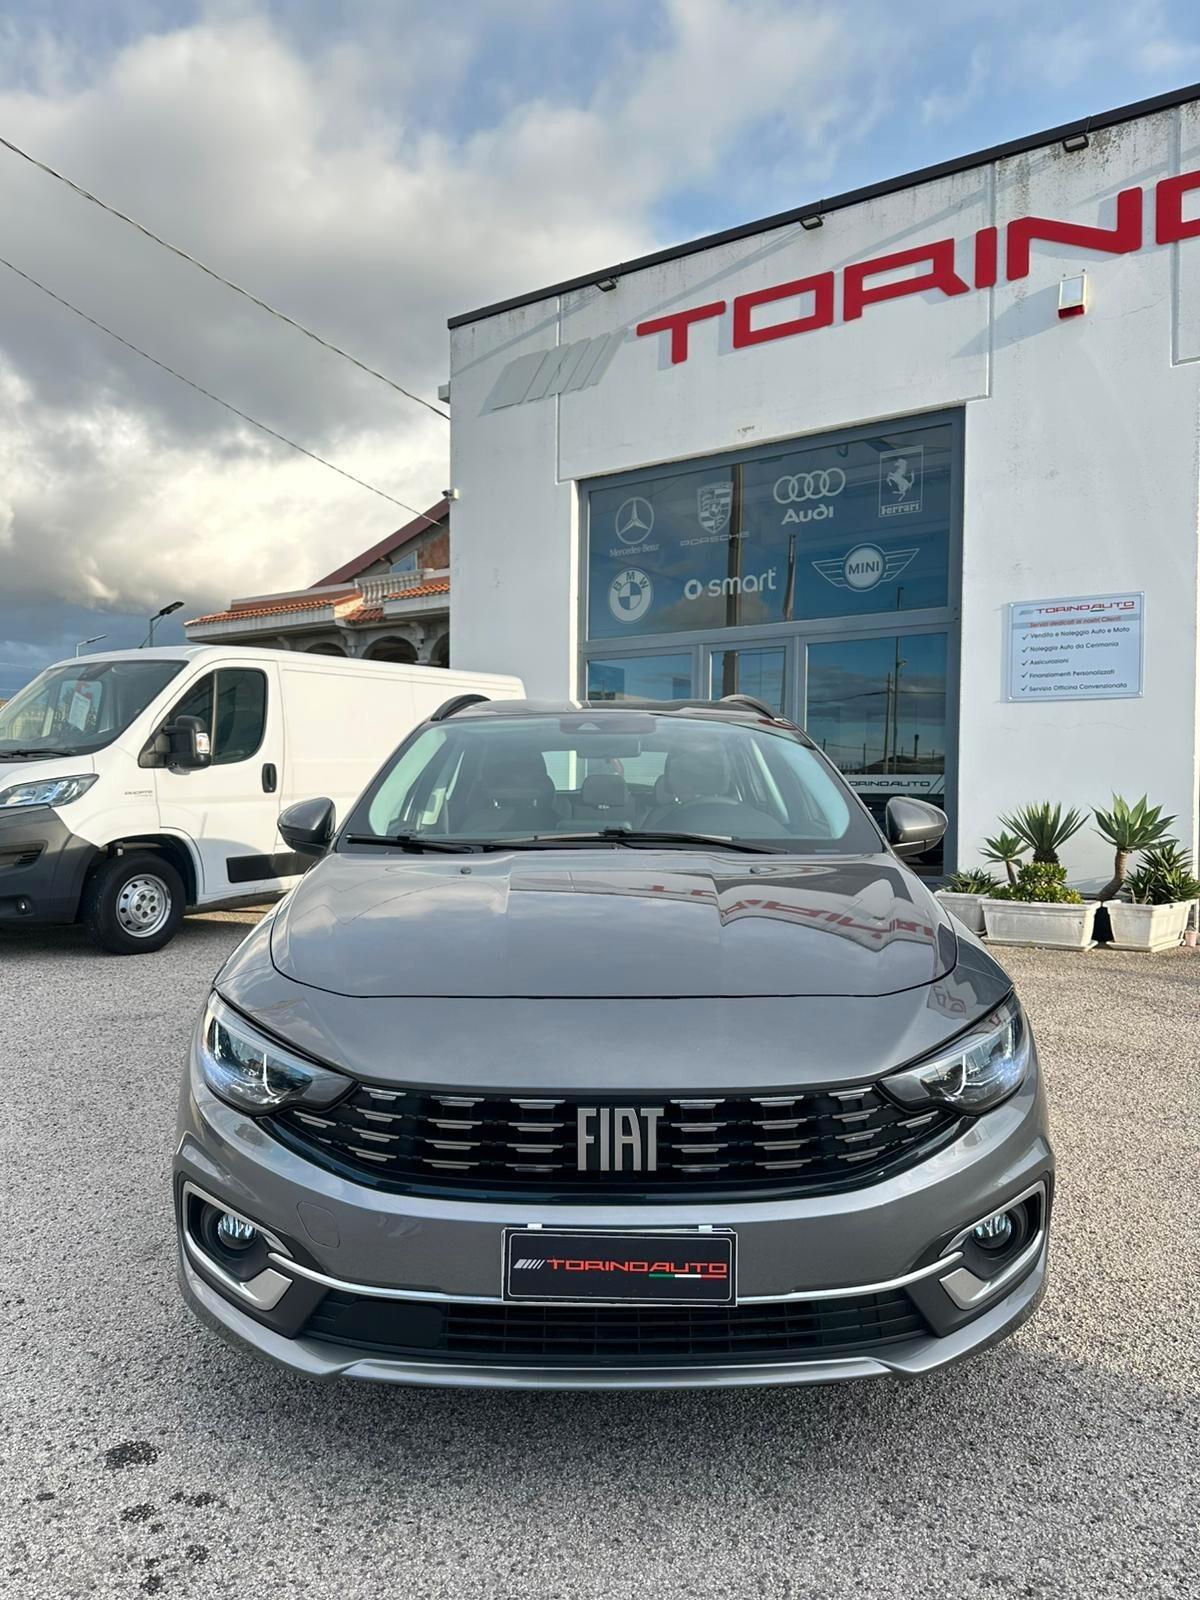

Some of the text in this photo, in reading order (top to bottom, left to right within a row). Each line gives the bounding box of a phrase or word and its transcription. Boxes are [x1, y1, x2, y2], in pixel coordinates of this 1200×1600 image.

[781, 504, 834, 526] Audi
[881, 503, 919, 515] Ferrari
[680, 531, 749, 546] PORSCHE
[848, 561, 880, 576] MINI
[613, 571, 650, 592] BMW
[708, 568, 777, 598] smart
[1036, 601, 1135, 614] TORINOAUTO
[1061, 629, 1090, 637] Noleggio
[1075, 642, 1085, 650] da
[1030, 658, 1069, 666] Assicurazioni
[1073, 668, 1115, 677] Personalizzati
[577, 1108, 664, 1171] FIAT
[547, 1258, 728, 1273] TORINOAUTO
